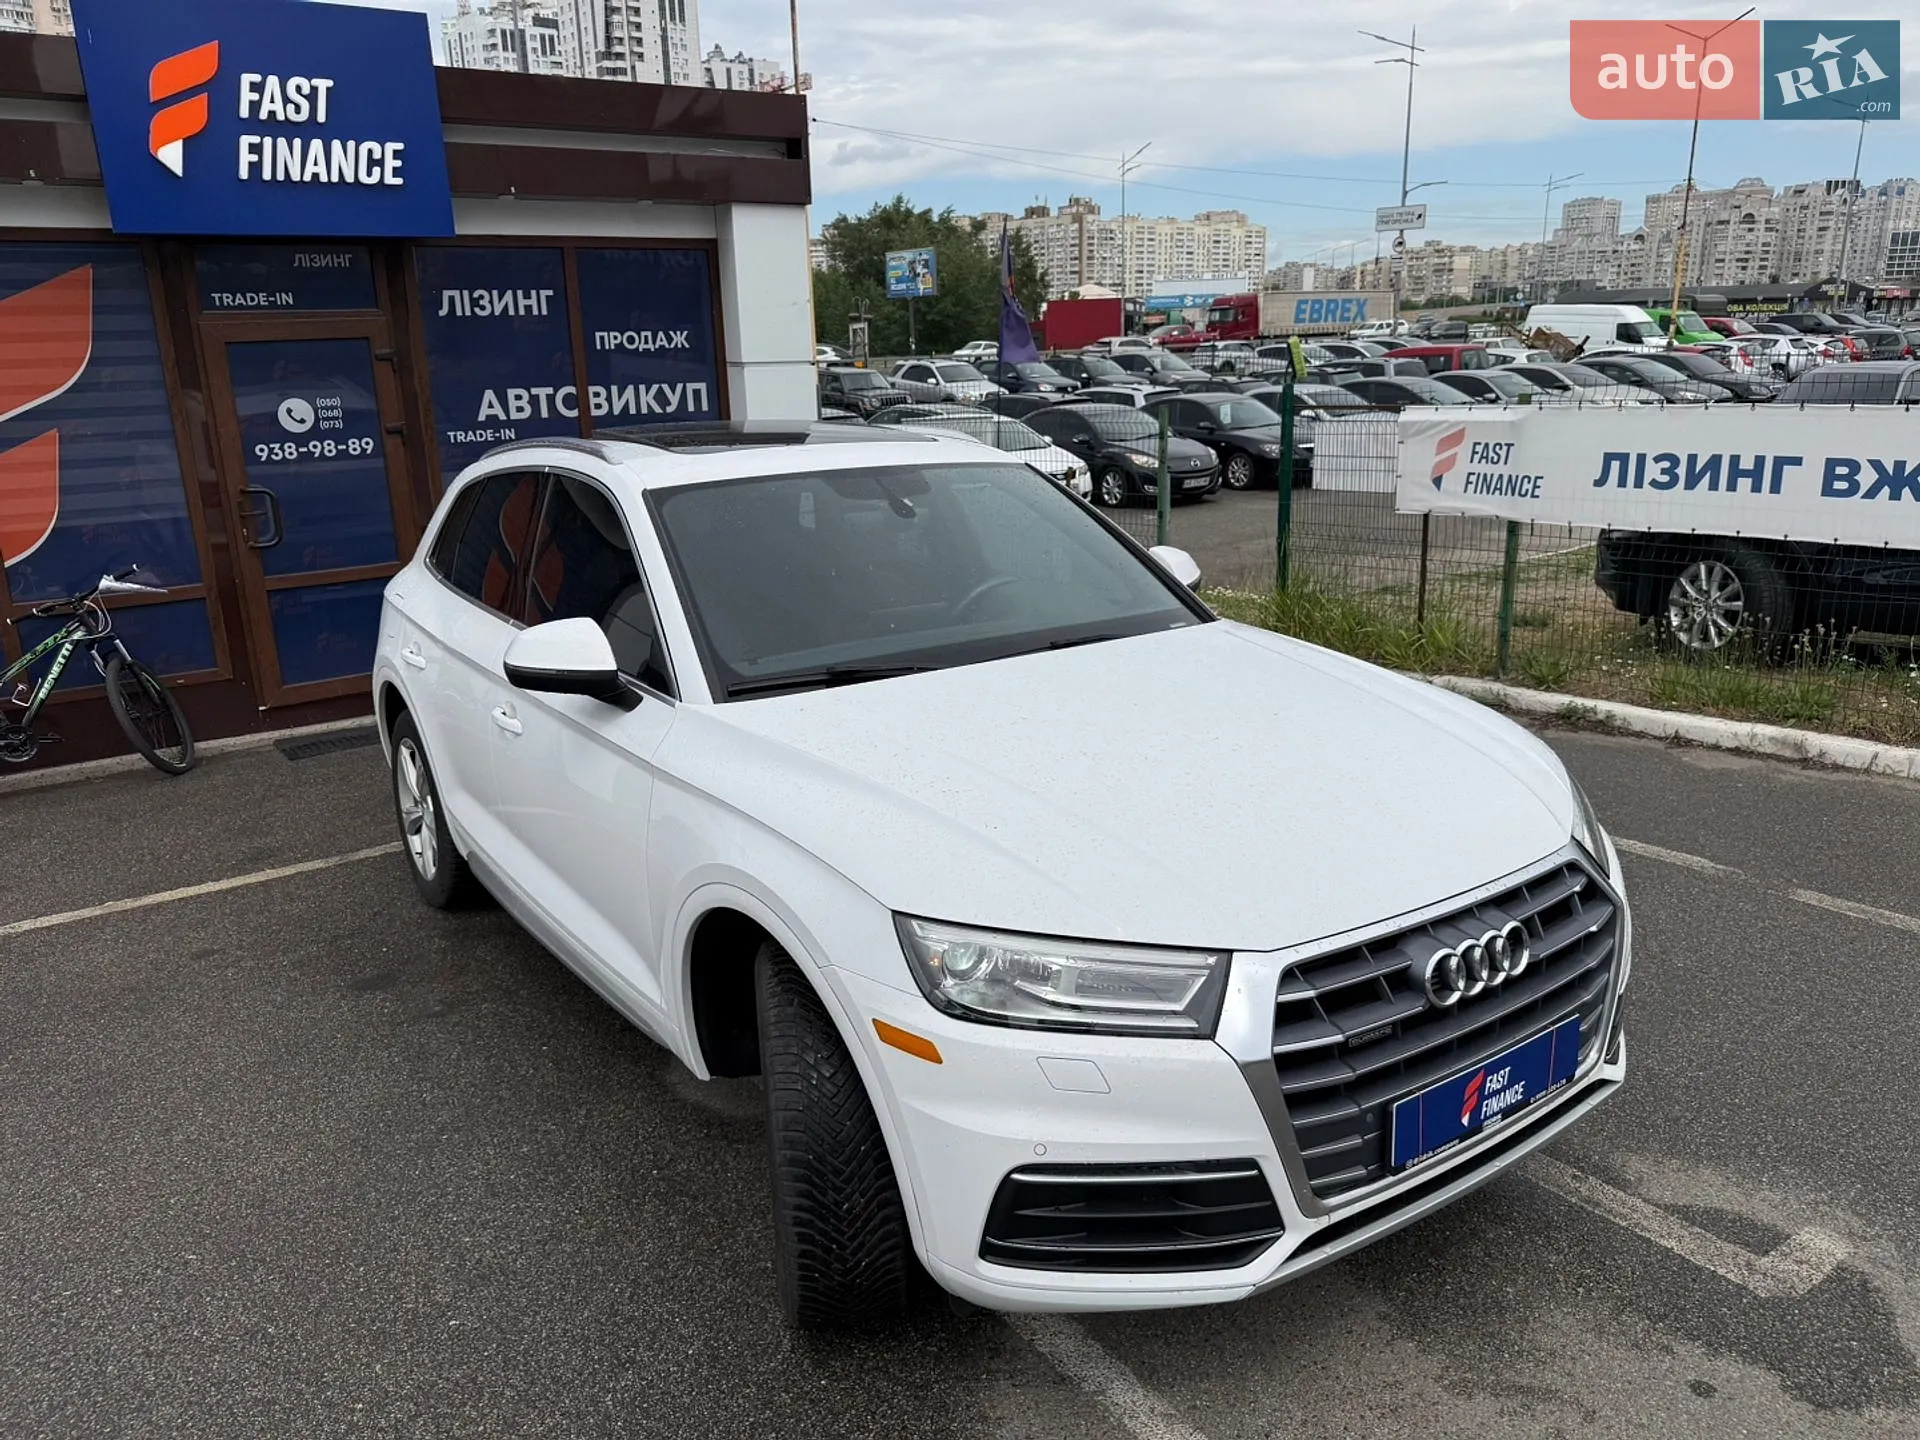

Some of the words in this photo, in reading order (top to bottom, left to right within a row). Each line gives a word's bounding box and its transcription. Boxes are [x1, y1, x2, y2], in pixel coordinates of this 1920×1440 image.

[238, 73, 334, 124] FAST
[238, 135, 405, 185] FINANCE
[293, 253, 353, 268] ЛІЗИНГ
[211, 292, 295, 307] TRADE-IN
[438, 289, 555, 317] ЛІЗИНГ
[1293, 298, 1369, 325] EBREX
[594, 330, 690, 352] ПРОДАЖ
[316, 397, 341, 408] (050)
[318, 407, 342, 419] (068)
[319, 418, 343, 430] (073)
[447, 428, 516, 444] TRADE-IN
[254, 437, 374, 462] 938-98-89
[1469, 441, 1515, 467] FAST
[1463, 472, 1544, 499] FINANCE
[1593, 451, 1803, 496] ЛІЗИНГ
[1484, 1066, 1512, 1096] FAST
[1480, 1080, 1526, 1120] FINANCE
